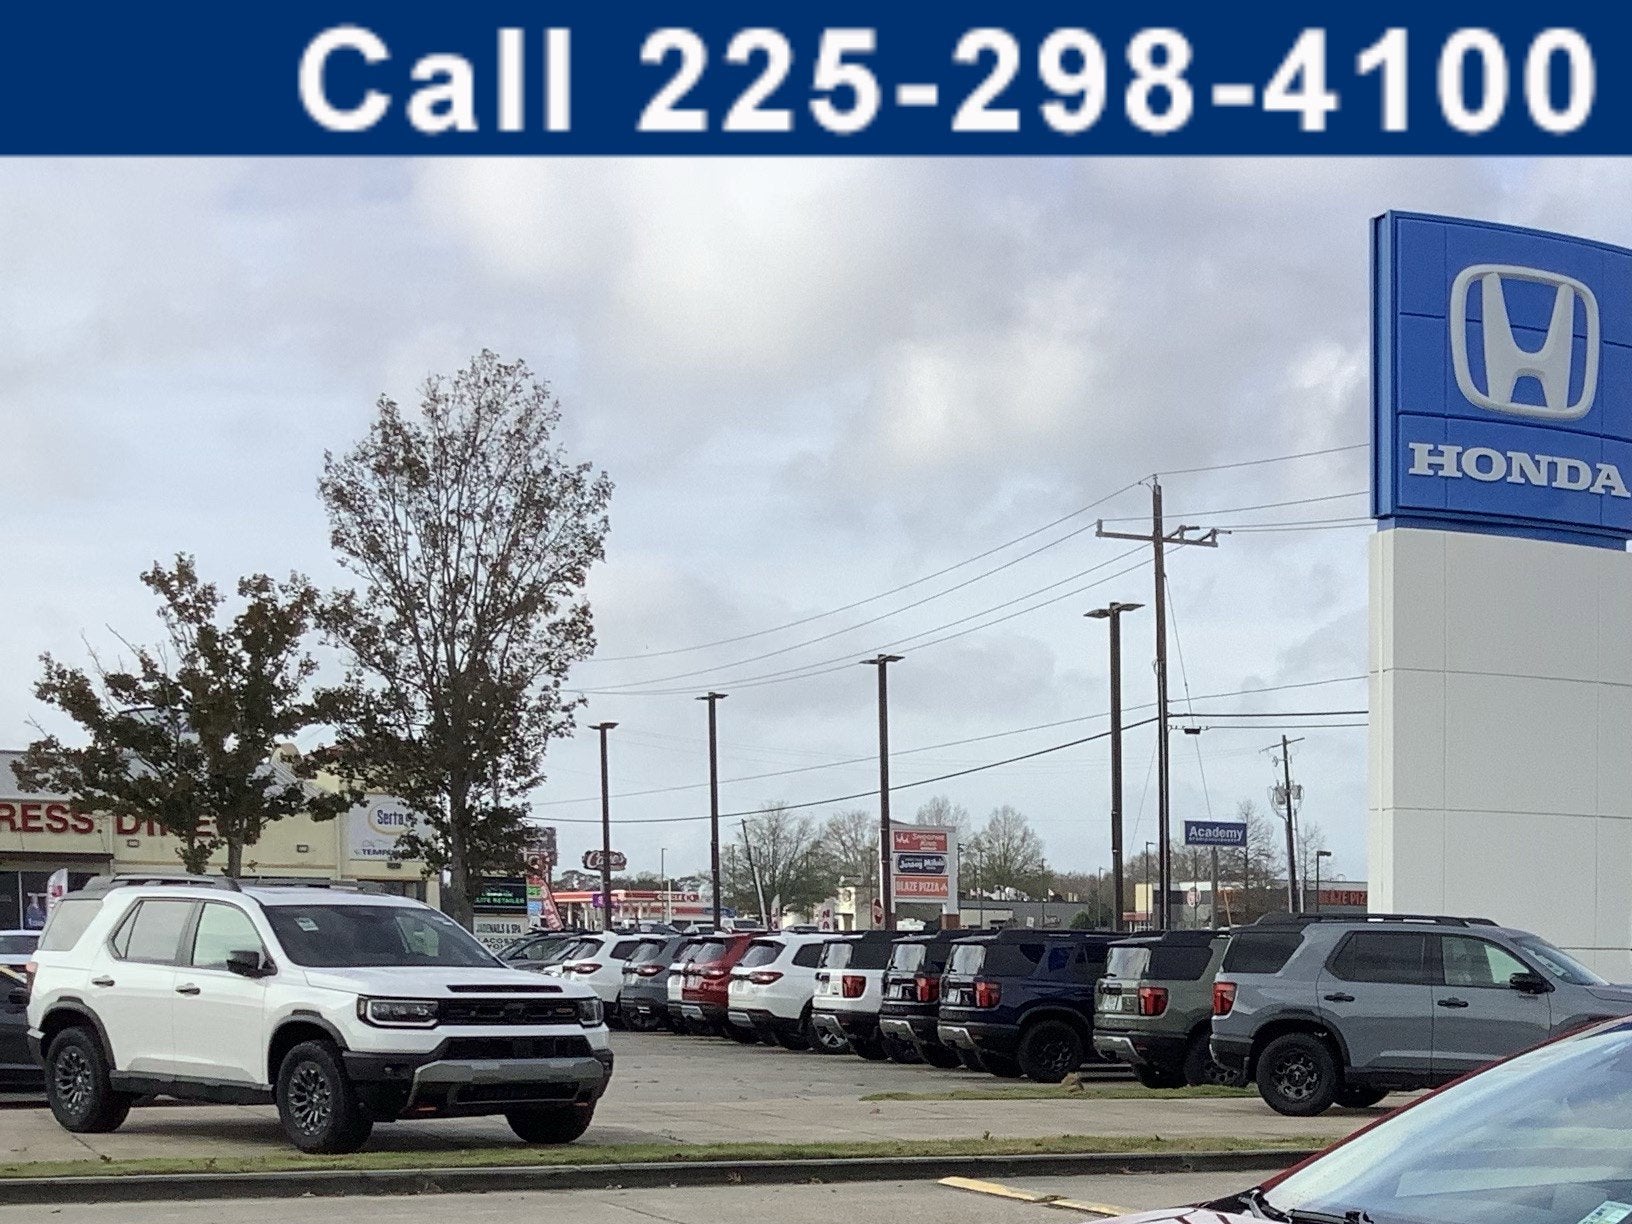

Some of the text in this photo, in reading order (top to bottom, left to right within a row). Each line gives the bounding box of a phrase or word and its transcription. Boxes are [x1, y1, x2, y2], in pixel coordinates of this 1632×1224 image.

[1408, 442, 1631, 498] HONDA
[377, 809, 404, 825] Serta
[1189, 826, 1243, 841] Academy
